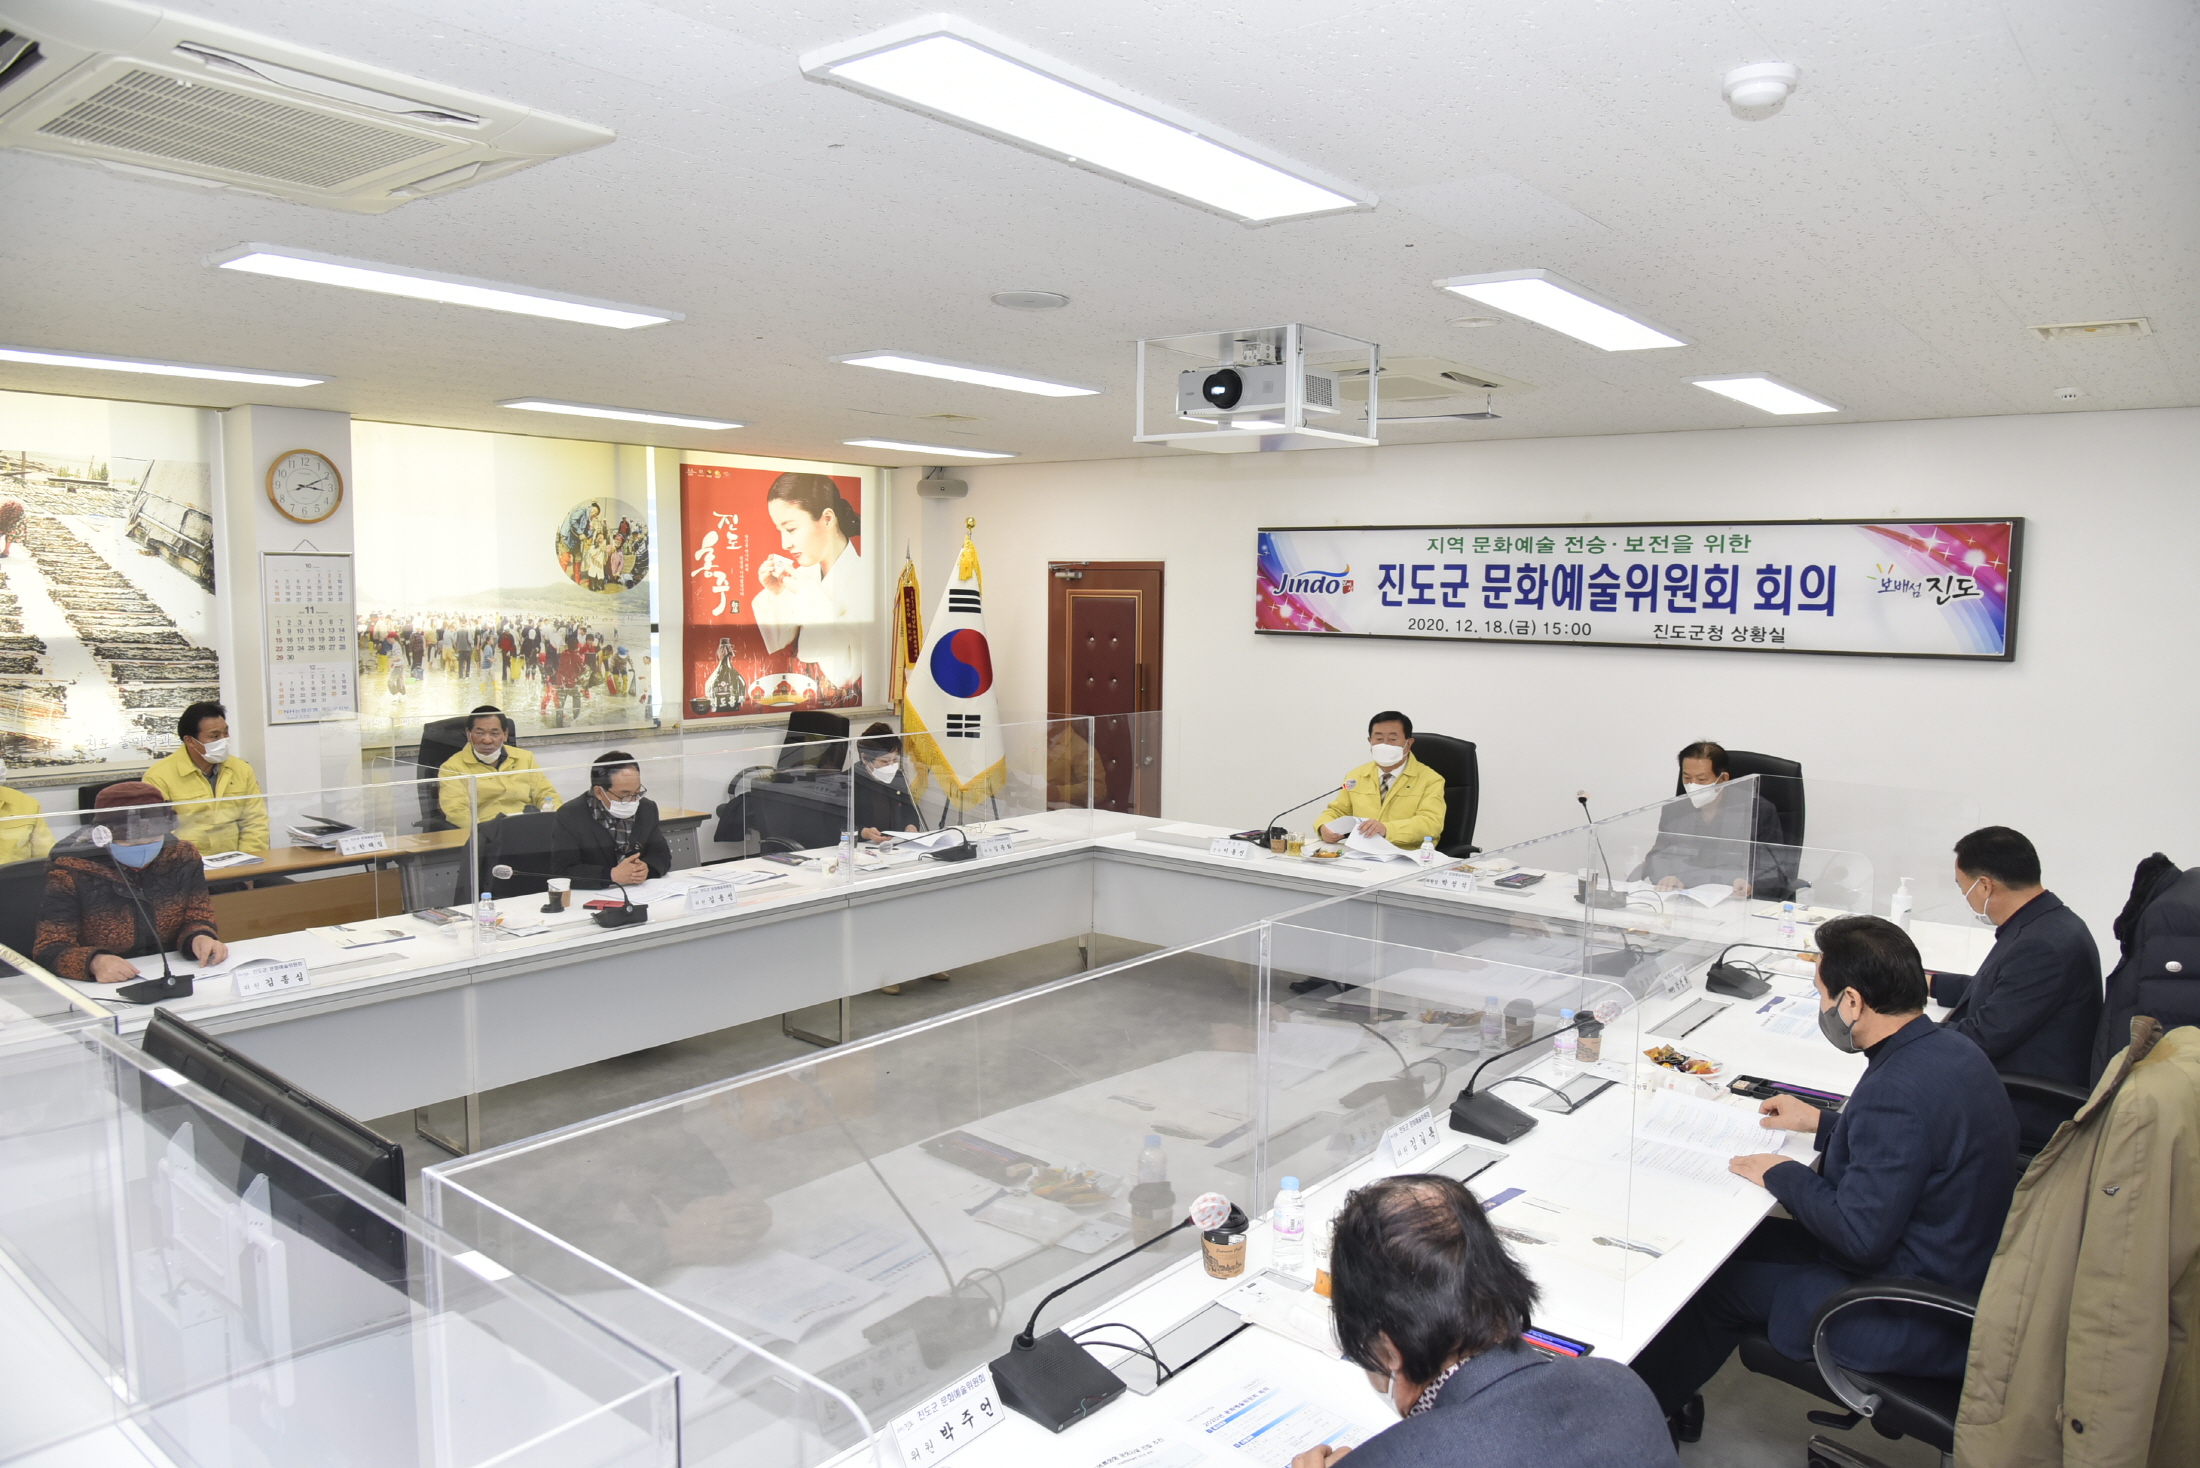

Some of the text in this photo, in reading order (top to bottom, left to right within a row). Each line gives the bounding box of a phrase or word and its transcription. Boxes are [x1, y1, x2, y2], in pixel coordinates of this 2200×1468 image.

[288, 460, 295, 468] 11
[301, 457, 309, 466] 12
[278, 470, 287, 478] 10
[275, 481, 280, 489] 9
[328, 484, 333, 492] 3
[290, 504, 295, 512] 7
[713, 511, 742, 550] 진도
[1427, 537, 1463, 554] 지역
[1472, 536, 1555, 554] 문화예술
[1704, 534, 1751, 553] 위한
[691, 531, 730, 616] 홍주
[1274, 574, 1340, 594] Jindo
[1378, 563, 1836, 616] 진도군 문화예술위원회 회의
[1878, 576, 1980, 605] 보배섬 진도
[1408, 618, 1591, 636] 2020. 12. 18.(금) 15:00
[1654, 624, 1784, 643] 진도군청 상황실
[86, 735, 110, 751] 진도
[917, 1401, 939, 1421] 진도군
[940, 1373, 986, 1407] 문화예술위원회
[911, 1397, 994, 1462] 위원 박주언
